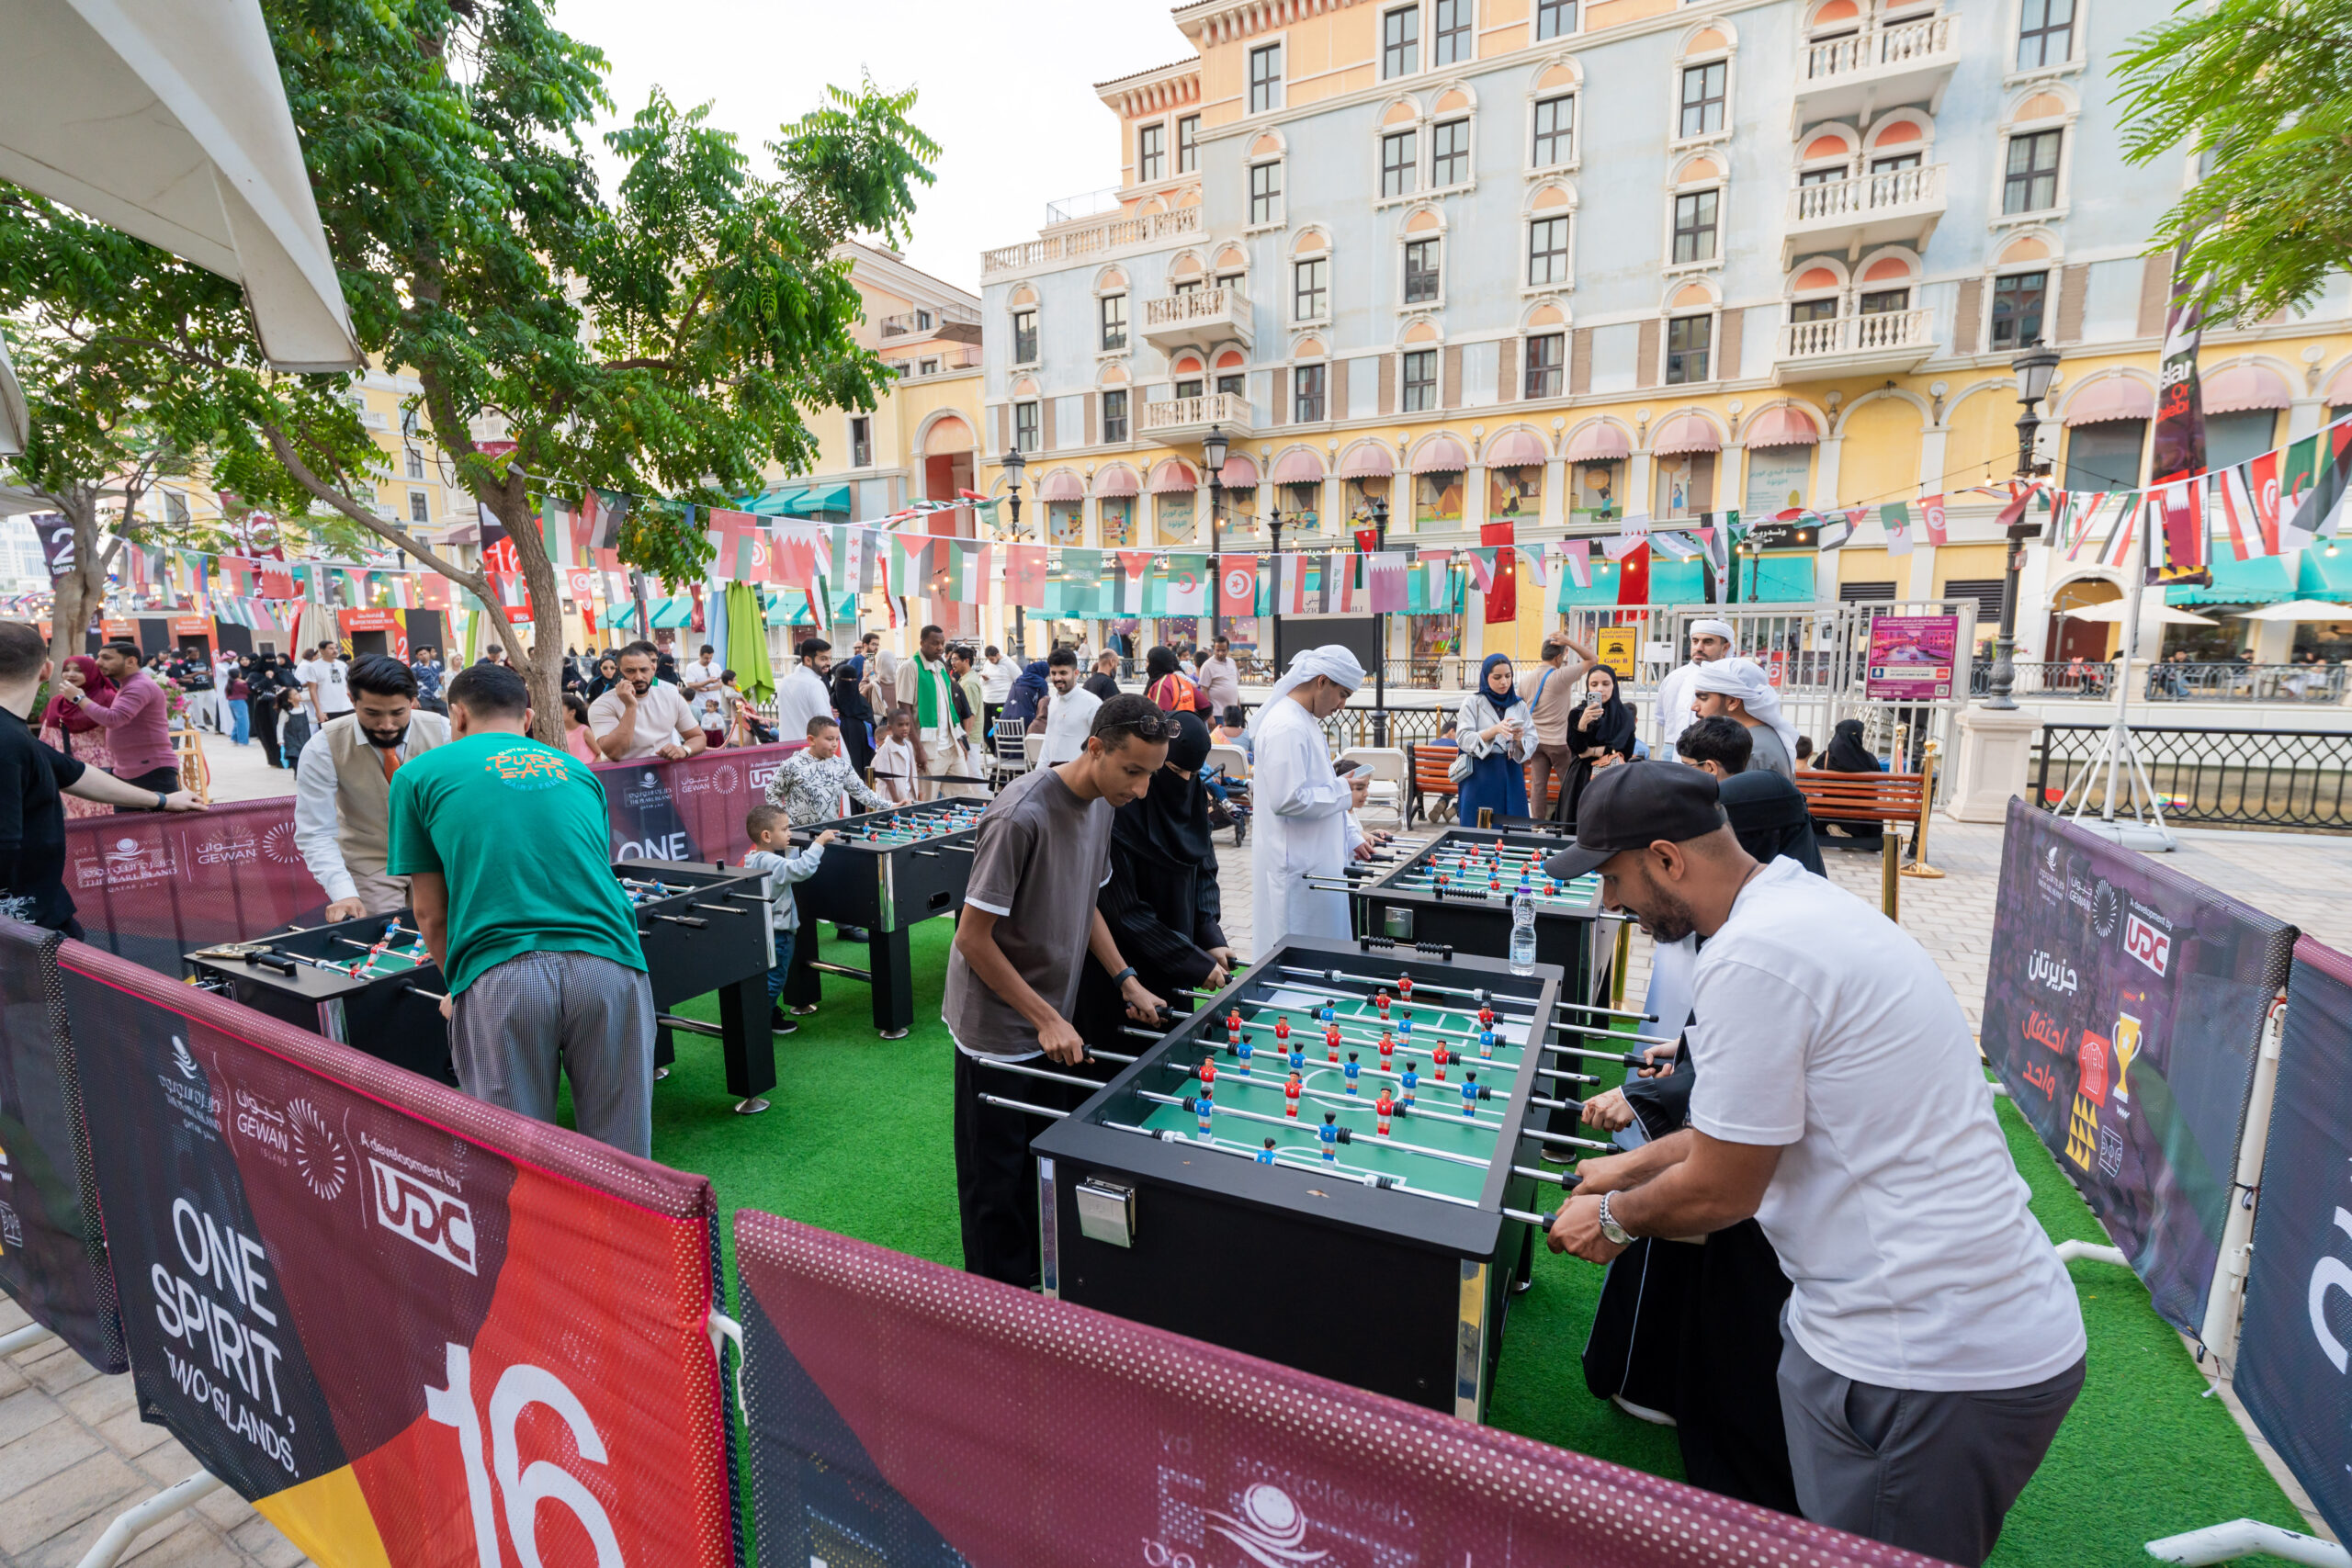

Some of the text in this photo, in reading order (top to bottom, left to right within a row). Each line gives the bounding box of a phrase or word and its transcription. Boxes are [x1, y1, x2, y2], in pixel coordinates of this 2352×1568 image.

[51, 527, 75, 565] 2
[486, 754, 565, 769] PURE
[498, 761, 569, 781] EATS
[503, 777, 560, 791] DAIRY FREE
[682, 783, 710, 794] GEWAN
[198, 848, 256, 865] GEWAN
[617, 831, 689, 862] ONE
[107, 885, 136, 893] QATAR
[2069, 890, 2091, 911] GEWAN
[2134, 900, 2165, 926] development
[2127, 917, 2168, 973] UDC
[2028, 948, 2077, 997] جزيرتان
[2022, 1060, 2056, 1102] واحد
[237, 1112, 288, 1153] GEWAN
[370, 1137, 443, 1182] development
[444, 1170, 462, 1193] by
[372, 1162, 474, 1271] UDC
[173, 1197, 277, 1327] ONE
[152, 1263, 296, 1434] SPIRIT,
[424, 1341, 627, 1568] 16
